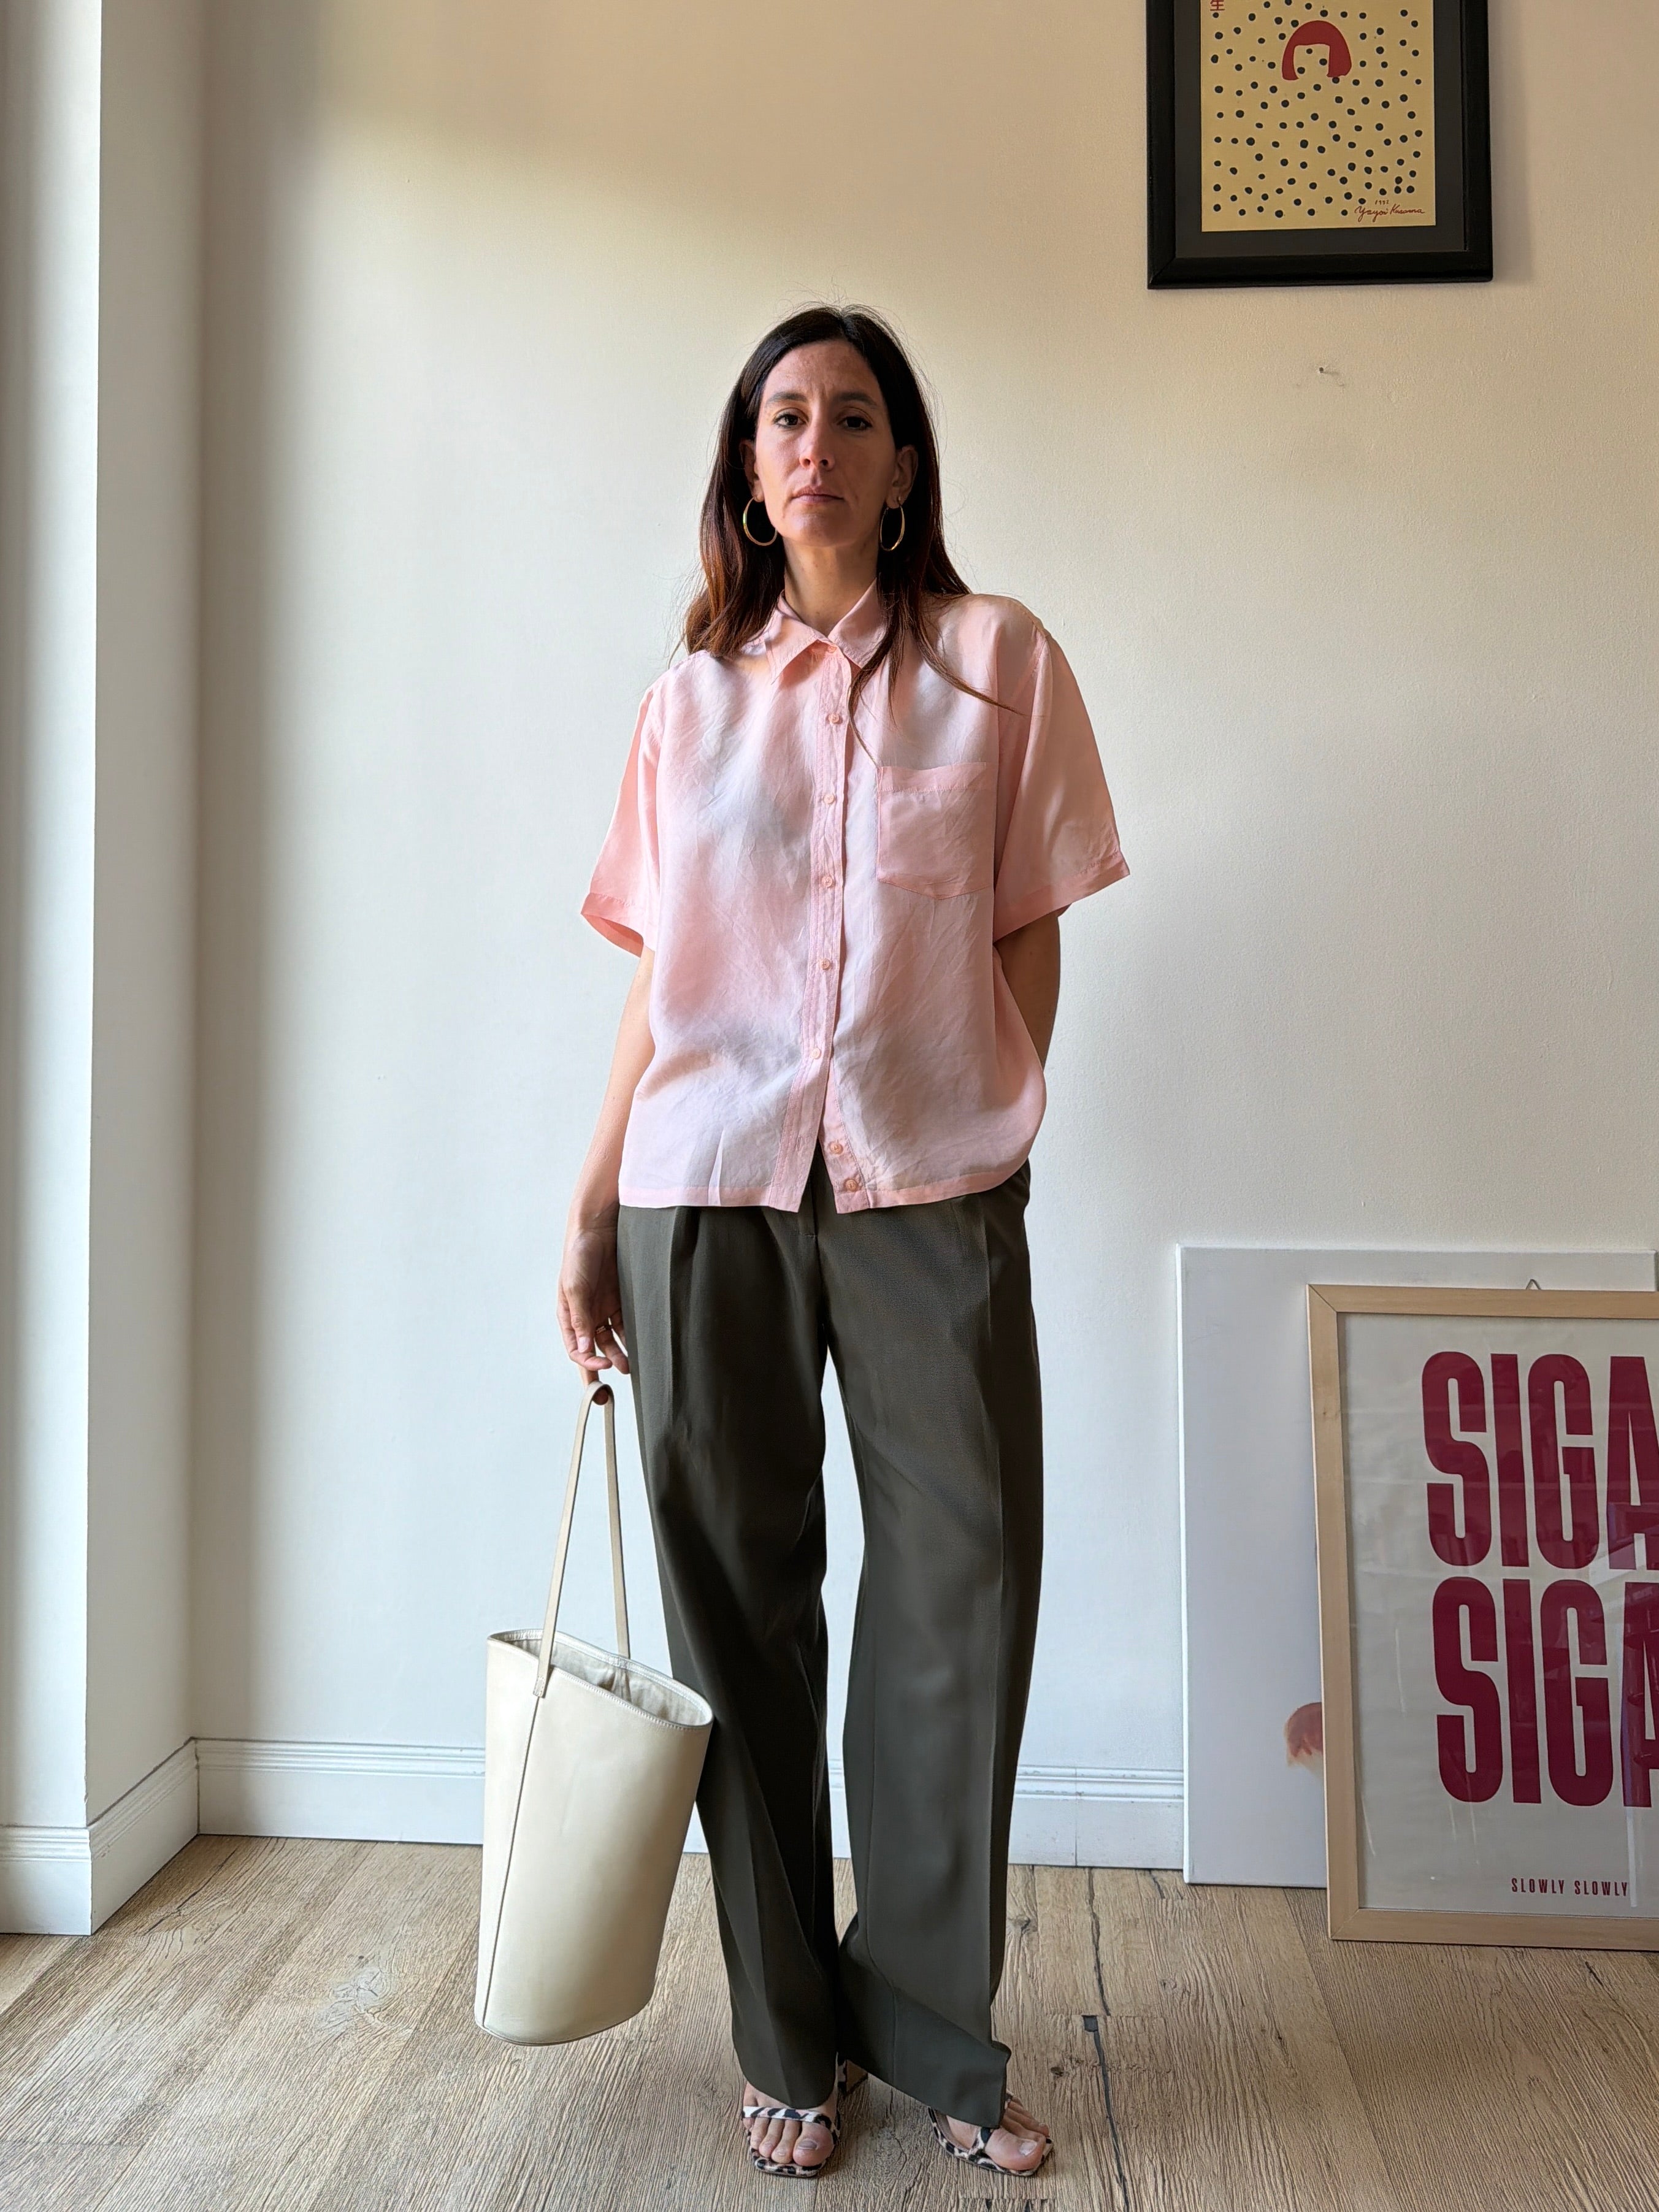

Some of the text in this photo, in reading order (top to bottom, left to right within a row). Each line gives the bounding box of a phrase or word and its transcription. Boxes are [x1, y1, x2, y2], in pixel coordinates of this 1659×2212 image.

[1422, 1351, 1659, 1571] SIGA
[1511, 1877, 1628, 1897] SLOWLY SLOWLY
